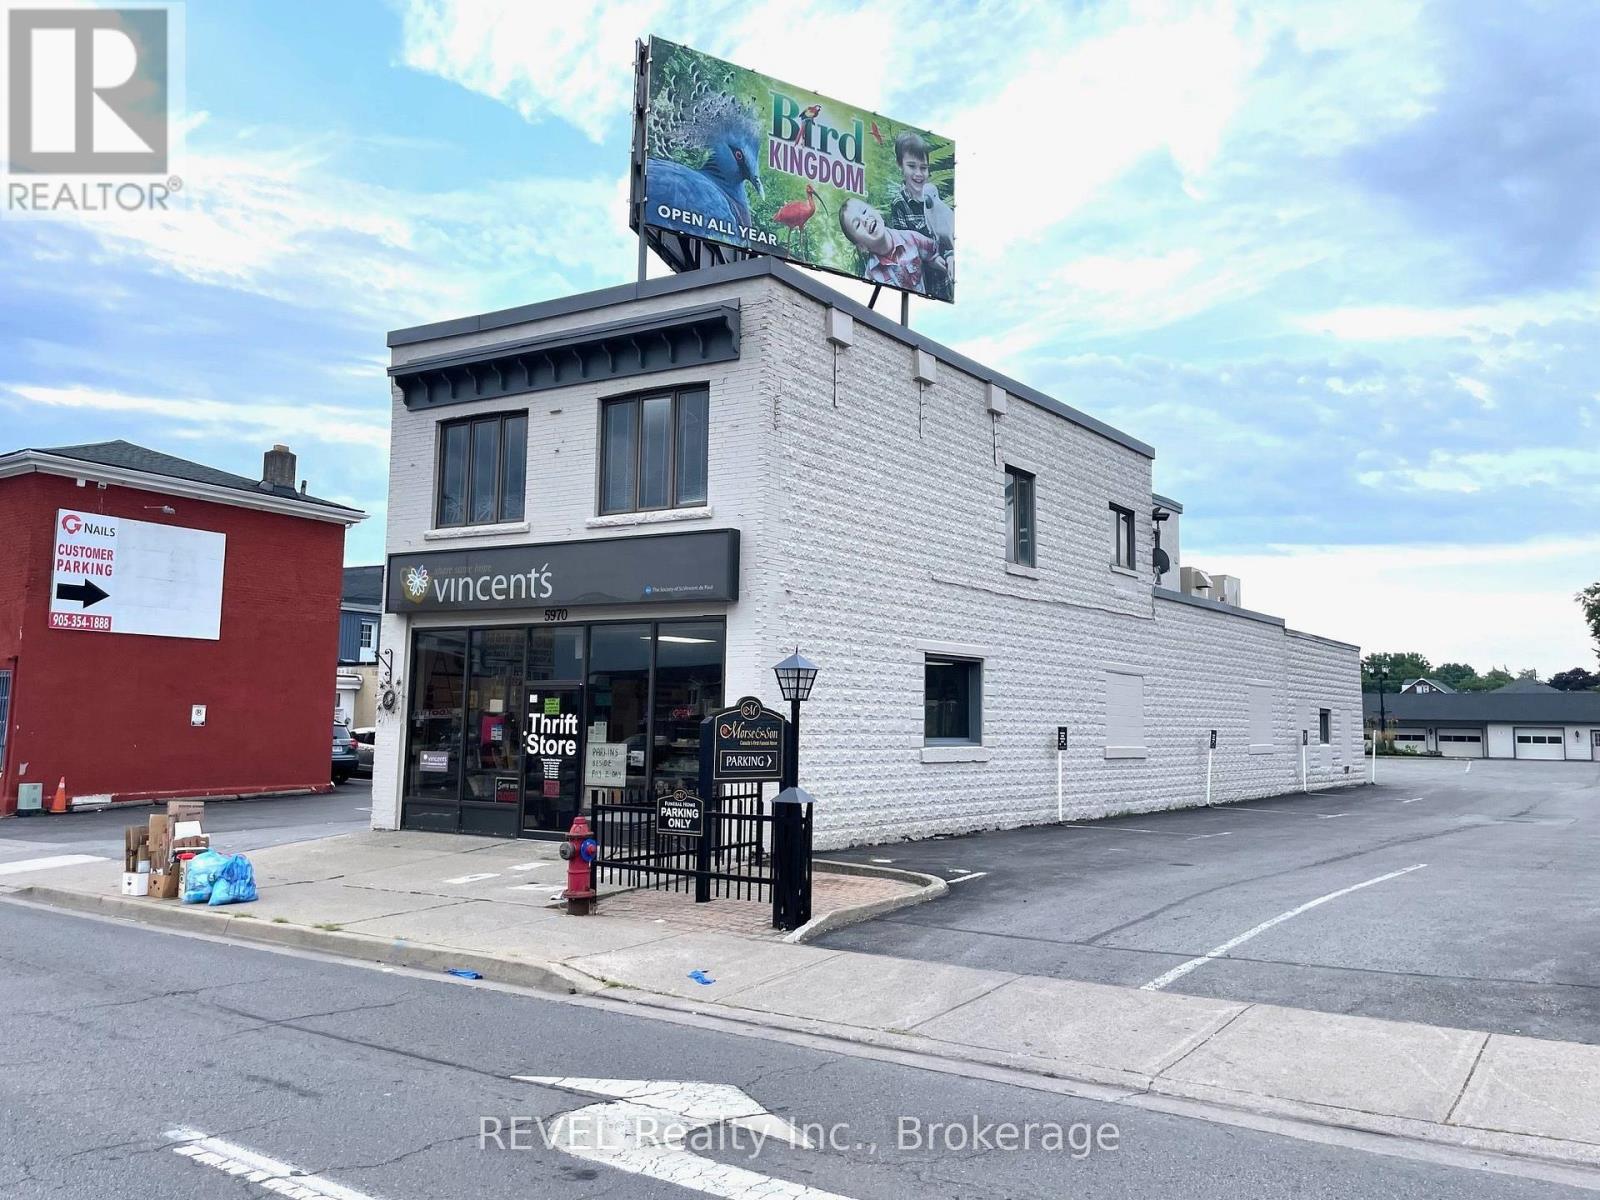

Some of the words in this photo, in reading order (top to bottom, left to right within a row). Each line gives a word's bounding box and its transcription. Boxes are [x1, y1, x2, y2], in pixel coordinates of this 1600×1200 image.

[768, 90, 865, 167] Bird
[768, 139, 866, 196] KINGDOM
[657, 204, 703, 227] OPEN
[707, 217, 735, 236] ALL
[739, 225, 778, 247] YEAR
[84, 522, 116, 537] NAILS
[58, 543, 114, 561] CUSTOMER
[56, 558, 113, 576] PARKING
[52, 613, 110, 630] 905-354-1888
[544, 608, 568, 621] 5970
[528, 713, 578, 735] Thrift
[526, 733, 577, 756] Store
[726, 755, 765, 767] PARKING
[660, 807, 699, 819] PARKING
[667, 817, 692, 829] ONLY
